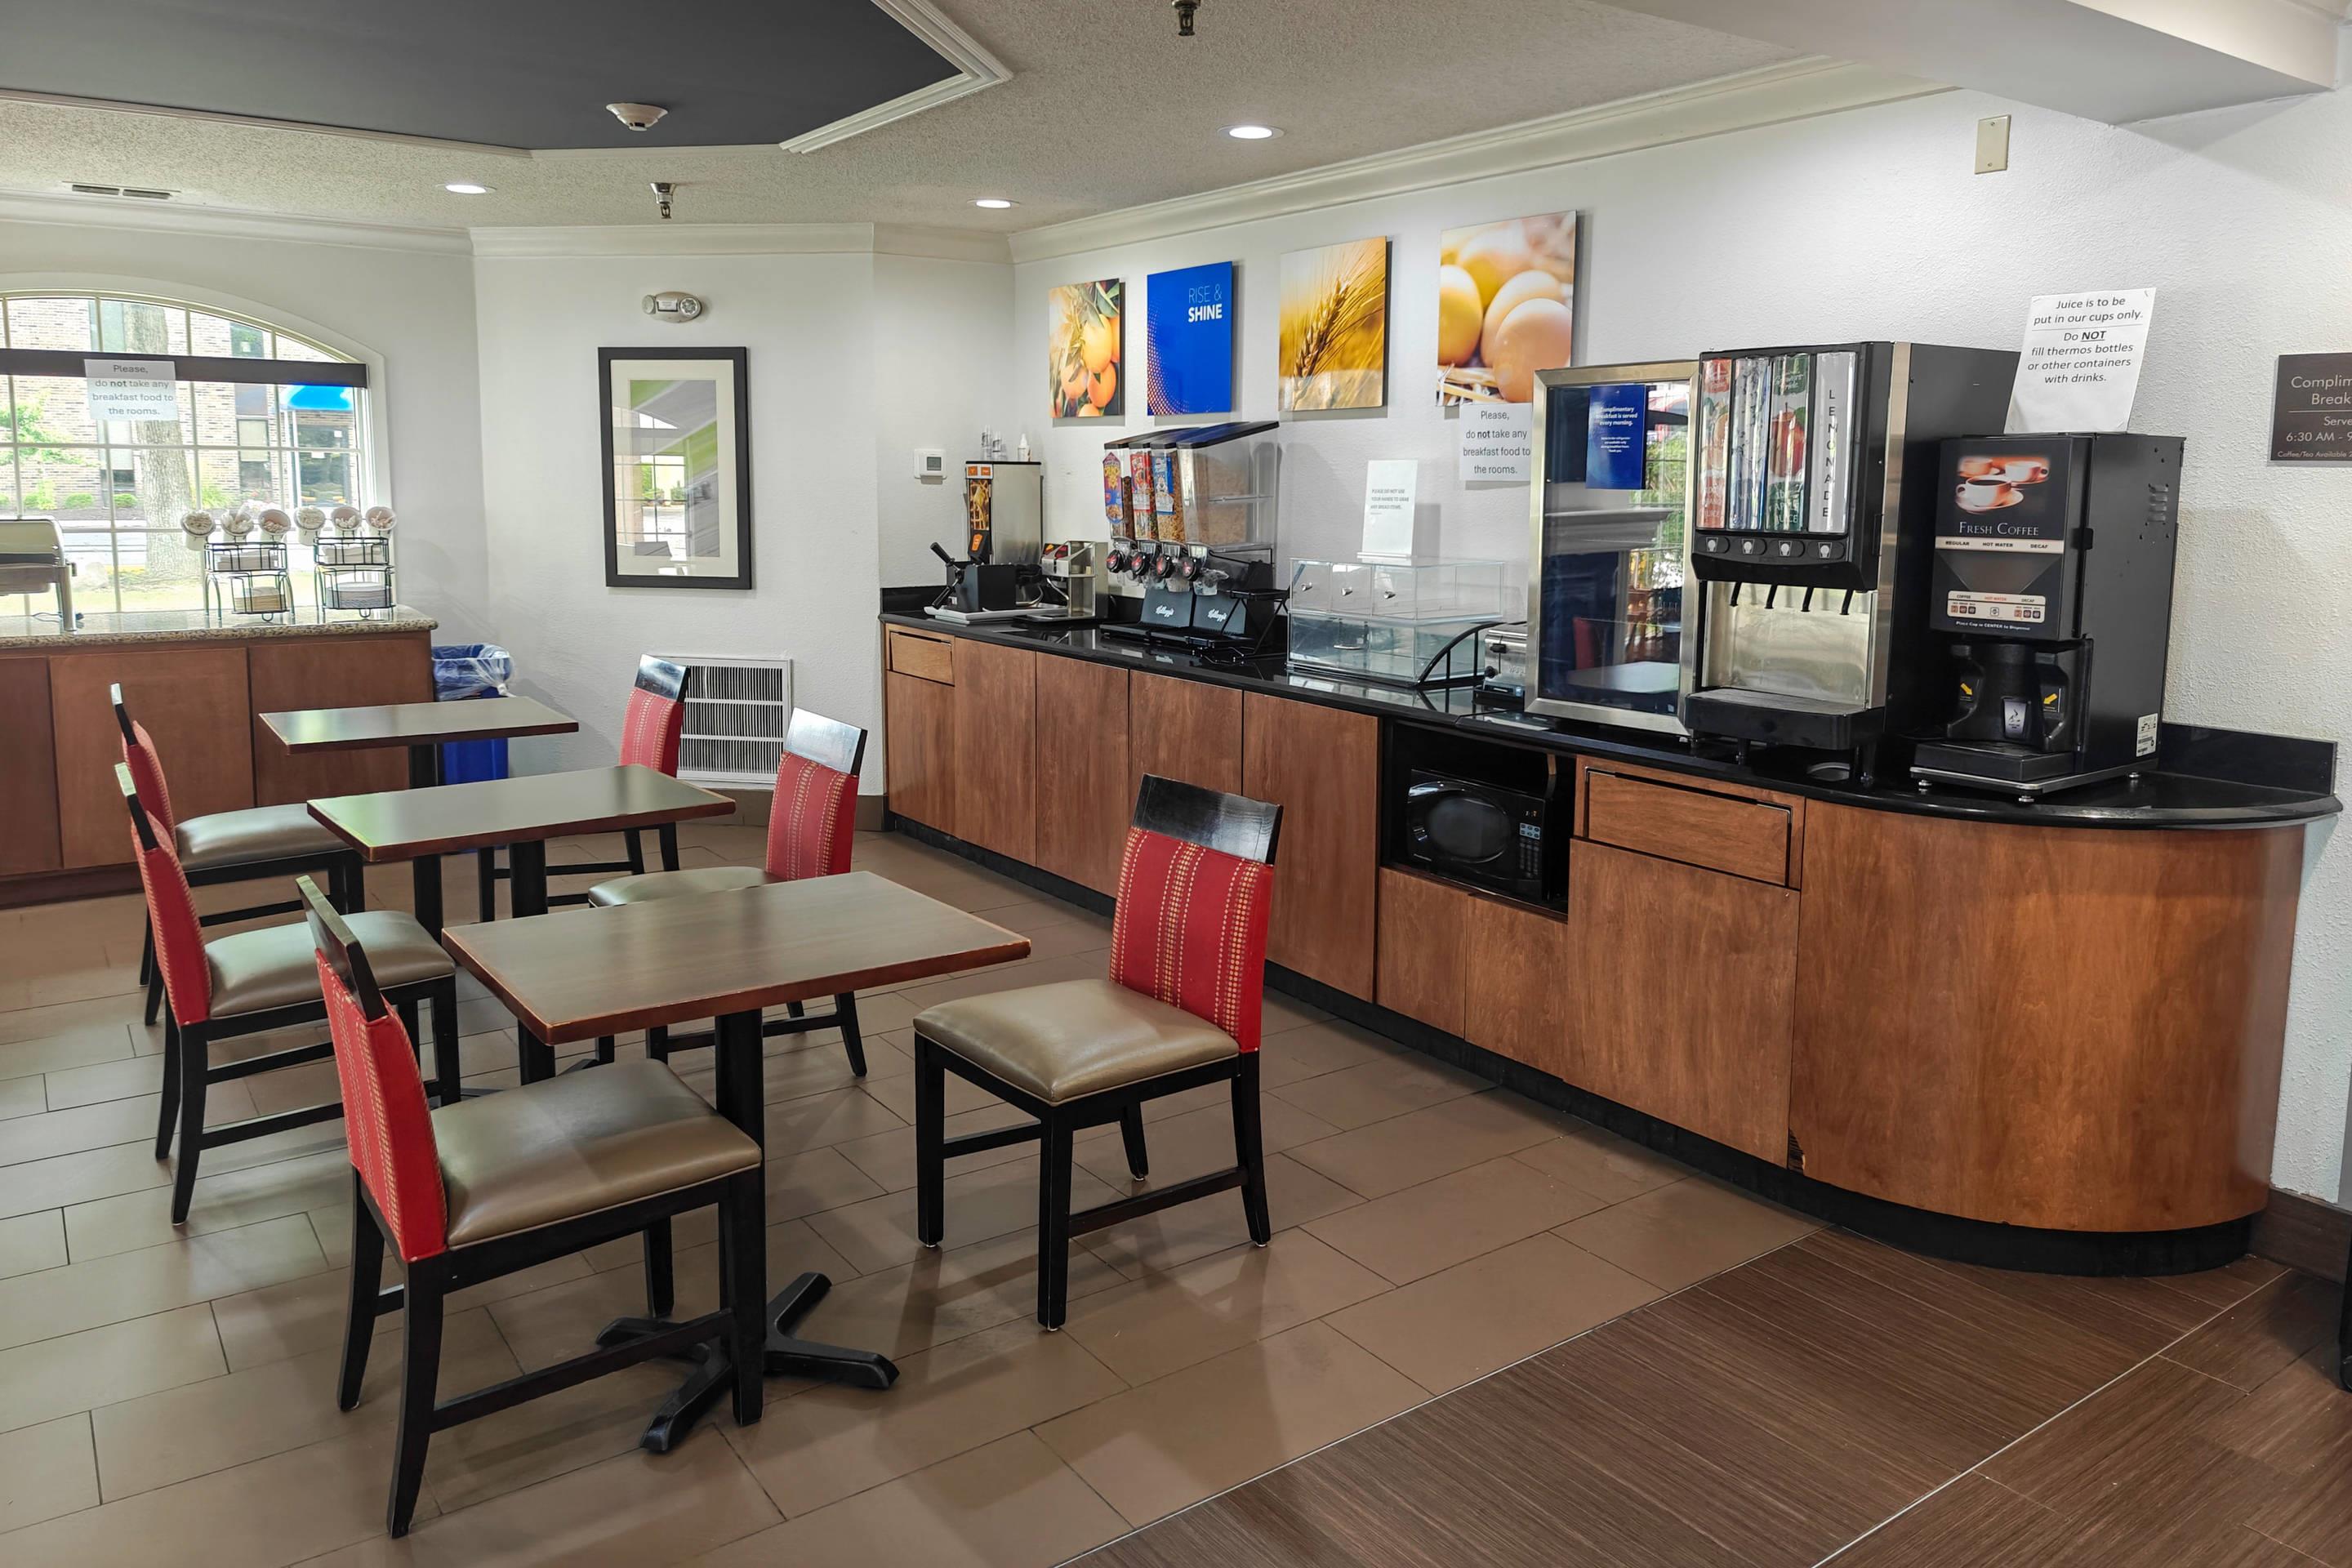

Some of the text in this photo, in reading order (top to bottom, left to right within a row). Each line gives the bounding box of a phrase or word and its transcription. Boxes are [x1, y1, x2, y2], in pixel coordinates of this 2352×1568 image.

[1188, 283, 1223, 304] RISE &
[2056, 296, 2126, 310] Juice is to be
[1187, 303, 1223, 323] SHINE
[2034, 309, 2144, 326] put in our cups only.
[2063, 331, 2107, 341] Do NOT
[2031, 343, 2134, 356] fill thermos bottles
[113, 364, 149, 374] Please,
[2027, 358, 2132, 371] or other containers
[2044, 372, 2107, 384] with drinks.
[2291, 374, 2352, 390] Complim
[95, 379, 170, 390] do not take any
[92, 393, 138, 401] breakfast
[140, 394, 162, 402] food
[1481, 410, 1510, 421] Please,
[2323, 416, 2352, 425] Serve
[1465, 429, 1527, 440] do not take any
[2286, 431, 2313, 442] 6:30
[2315, 431, 2335, 442] AM
[1463, 446, 1530, 457] breakfast food to
[2315, 450, 2347, 458] Available
[1473, 464, 1517, 474] the rooms.
[1775, 501, 1799, 510] APLE
[1776, 514, 1799, 523] JUCE
[1959, 521, 2039, 536] FRESH COFFEE
